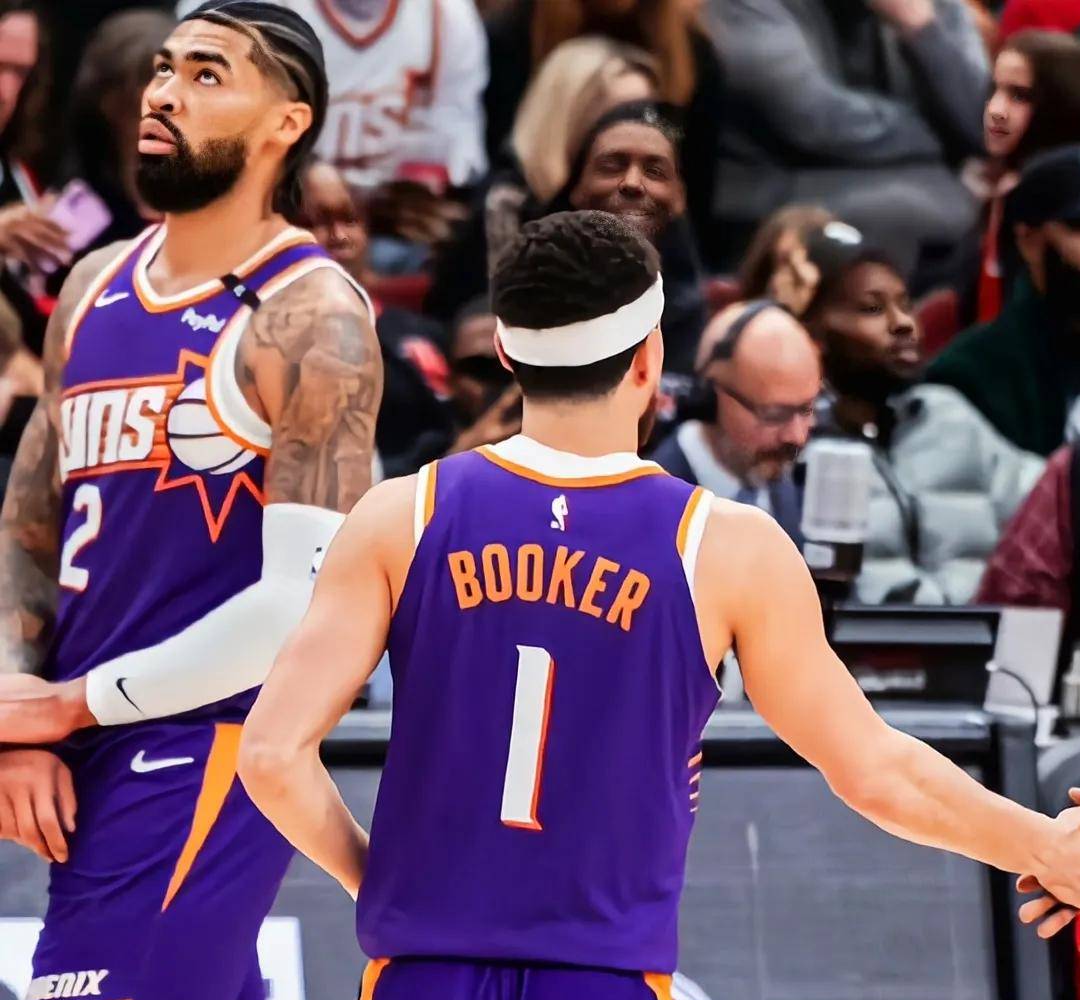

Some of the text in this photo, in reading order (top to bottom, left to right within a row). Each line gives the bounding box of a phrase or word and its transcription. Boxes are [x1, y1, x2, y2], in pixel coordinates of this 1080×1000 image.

[59, 386, 166, 484] UNS
[59, 483, 103, 593] 2
[447, 543, 651, 632] BOOKER
[500, 644, 555, 832] 1
